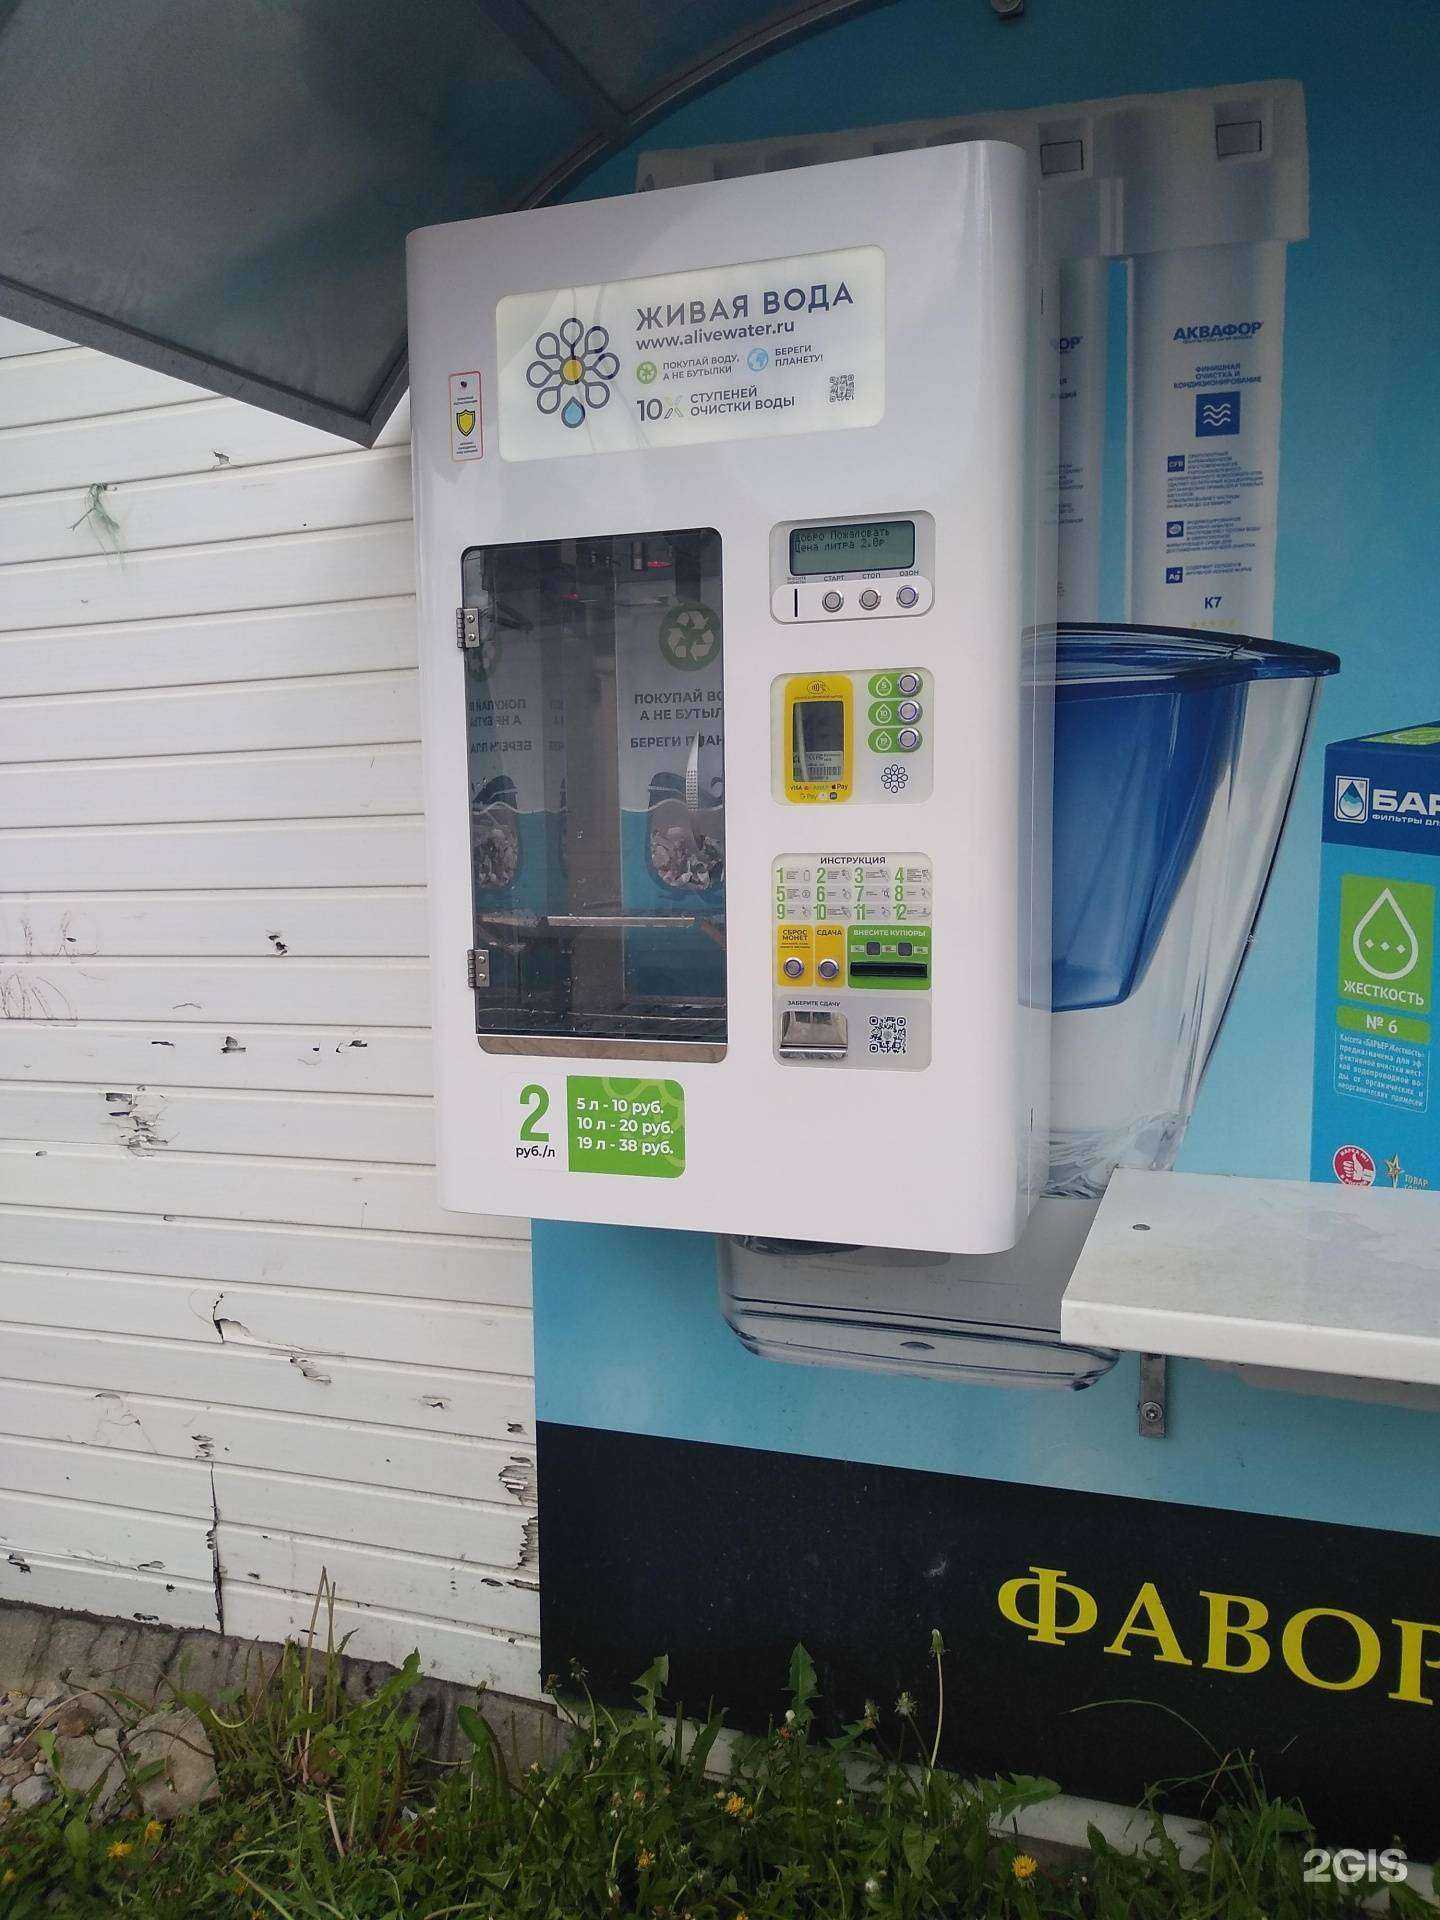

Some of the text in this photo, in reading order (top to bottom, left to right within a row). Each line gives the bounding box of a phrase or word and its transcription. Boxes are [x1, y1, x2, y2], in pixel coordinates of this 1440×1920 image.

[636, 281, 854, 331] ЖИВАЯ ВОДА
[635, 321, 795, 350] www.alivewater.ru
[1173, 321, 1262, 341] АКВАФОР
[775, 344, 812, 357] БЕРЕГИ
[662, 353, 740, 370] ПОКУПАЙ ВОДУ,
[775, 354, 824, 367] ПЛАНЕТУ!
[662, 366, 732, 381] А НЕ БУТЫЛКИ
[690, 385, 758, 404] СТУПЕНЕЙ
[690, 396, 795, 417] ОЧИСТКИ ВОДЫ
[830, 528, 890, 540] Пожаловать
[824, 541, 855, 551] литра
[823, 574, 845, 582] СТАРТ
[634, 688, 703, 705] ПОКУПАЙ
[640, 710, 650, 720] А
[653, 709, 672, 720] НЕ
[630, 735, 681, 748] БЕРЕГИ
[820, 856, 886, 865] ИНСТРУКЦИЯ
[776, 867, 784, 883] 1
[816, 867, 826, 883] 2
[854, 867, 864, 883] 3
[894, 867, 905, 883] 4
[776, 885, 785, 902] 5
[816, 885, 825, 902] 6
[854, 885, 864, 901] 7
[894, 885, 903, 901] 8
[776, 903, 785, 919] 9
[813, 903, 826, 920] 10
[853, 903, 866, 920] 11
[893, 903, 907, 920] 12
[890, 929, 926, 937] КУПЮРЫ
[1343, 979, 1425, 1006] ЖЕСТКОСТЬ
[1366, 1013, 1398, 1034] № 6
[518, 1083, 551, 1142] 2
[576, 1097, 586, 1111] 5
[588, 1100, 599, 1111] л
[611, 1099, 628, 1112] 10
[632, 1100, 664, 1116] руб.
[576, 1117, 593, 1130] 10
[596, 1119, 606, 1130] л
[619, 1118, 639, 1132] 20
[642, 1121, 674, 1136] руб.
[515, 1144, 556, 1158] руб./л
[577, 1136, 593, 1149] 19
[596, 1139, 606, 1150] л
[619, 1139, 638, 1152] 38
[641, 1141, 674, 1156] руб.
[997, 1565, 1440, 1706] ФАВОР
